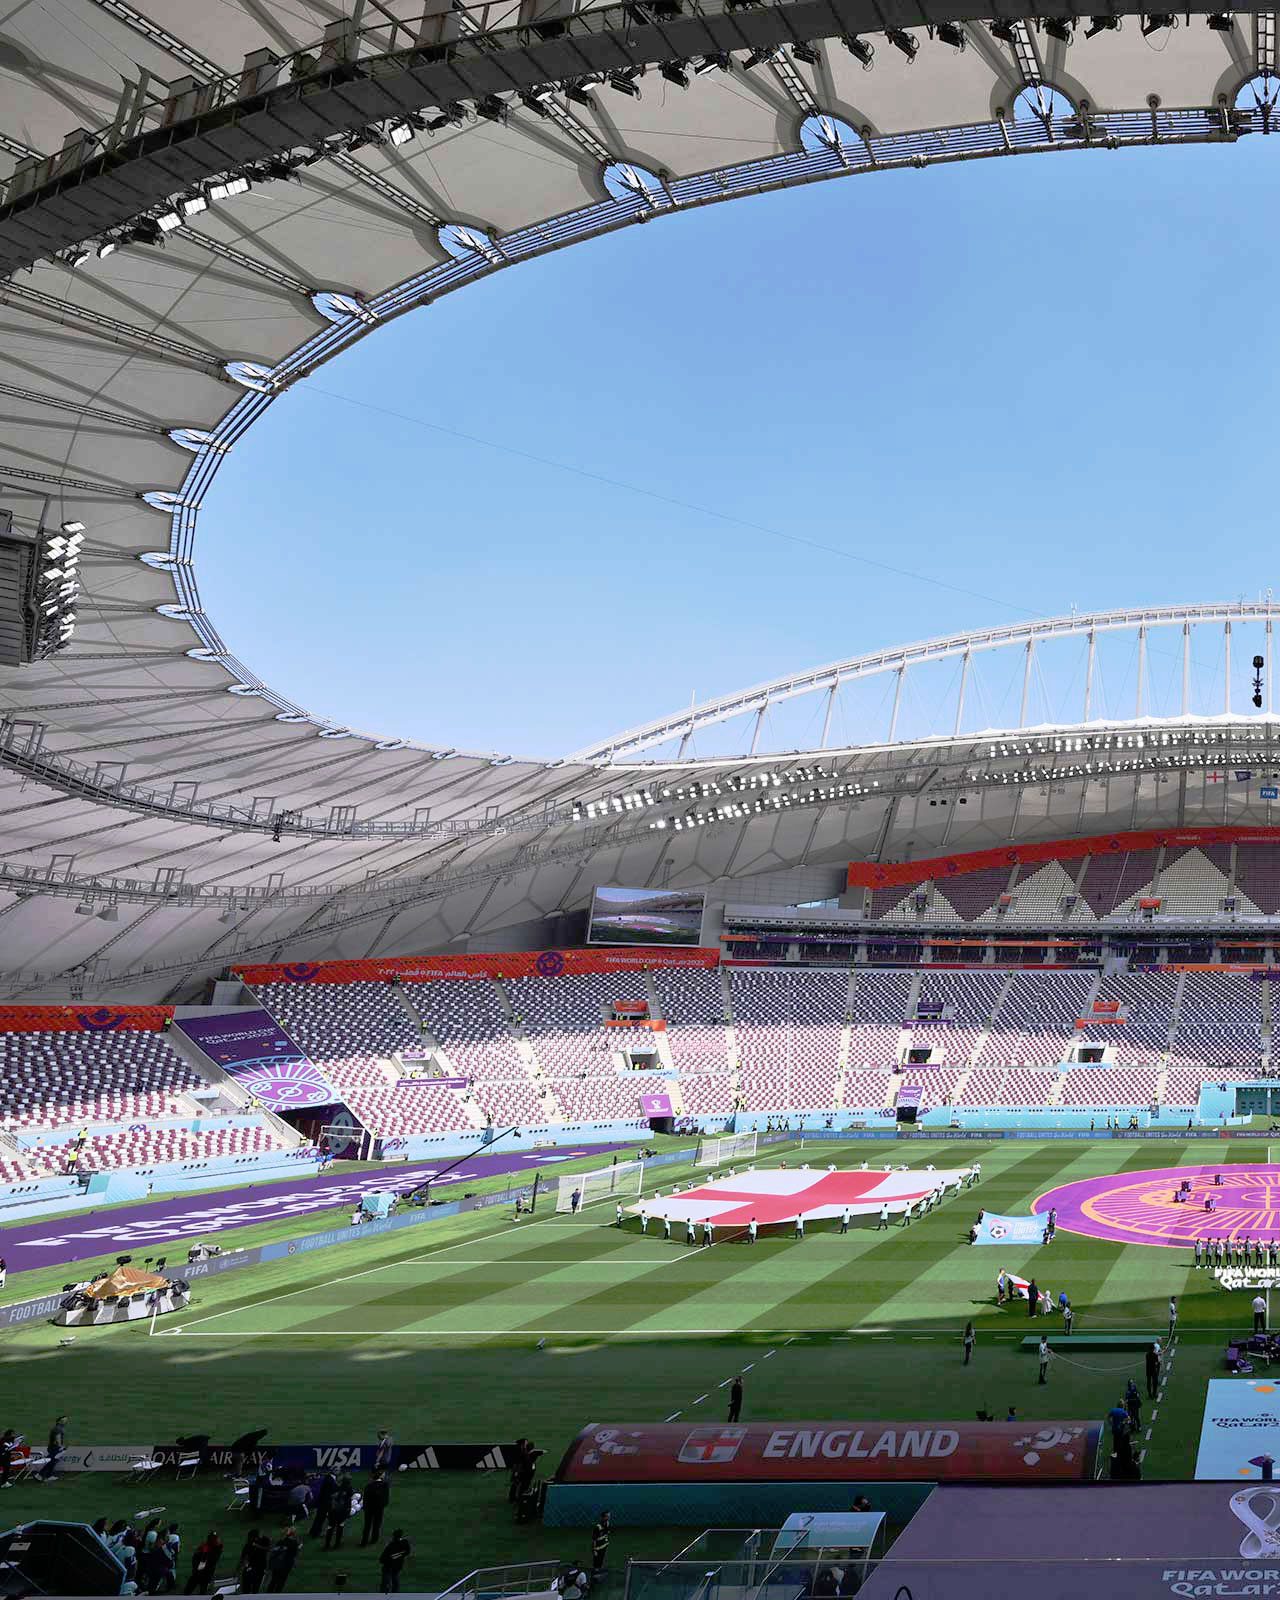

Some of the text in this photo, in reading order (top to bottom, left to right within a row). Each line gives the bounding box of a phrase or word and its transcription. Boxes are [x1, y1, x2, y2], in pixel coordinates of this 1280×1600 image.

[184, 1263, 209, 1278] FIFA
[1214, 1266, 1244, 1278] FIFA
[9, 1298, 62, 1323] FOOTBALL
[762, 1430, 960, 1459] ENGLAND
[312, 1447, 361, 1468] VISA
[1162, 1569, 1217, 1581] FIFA
